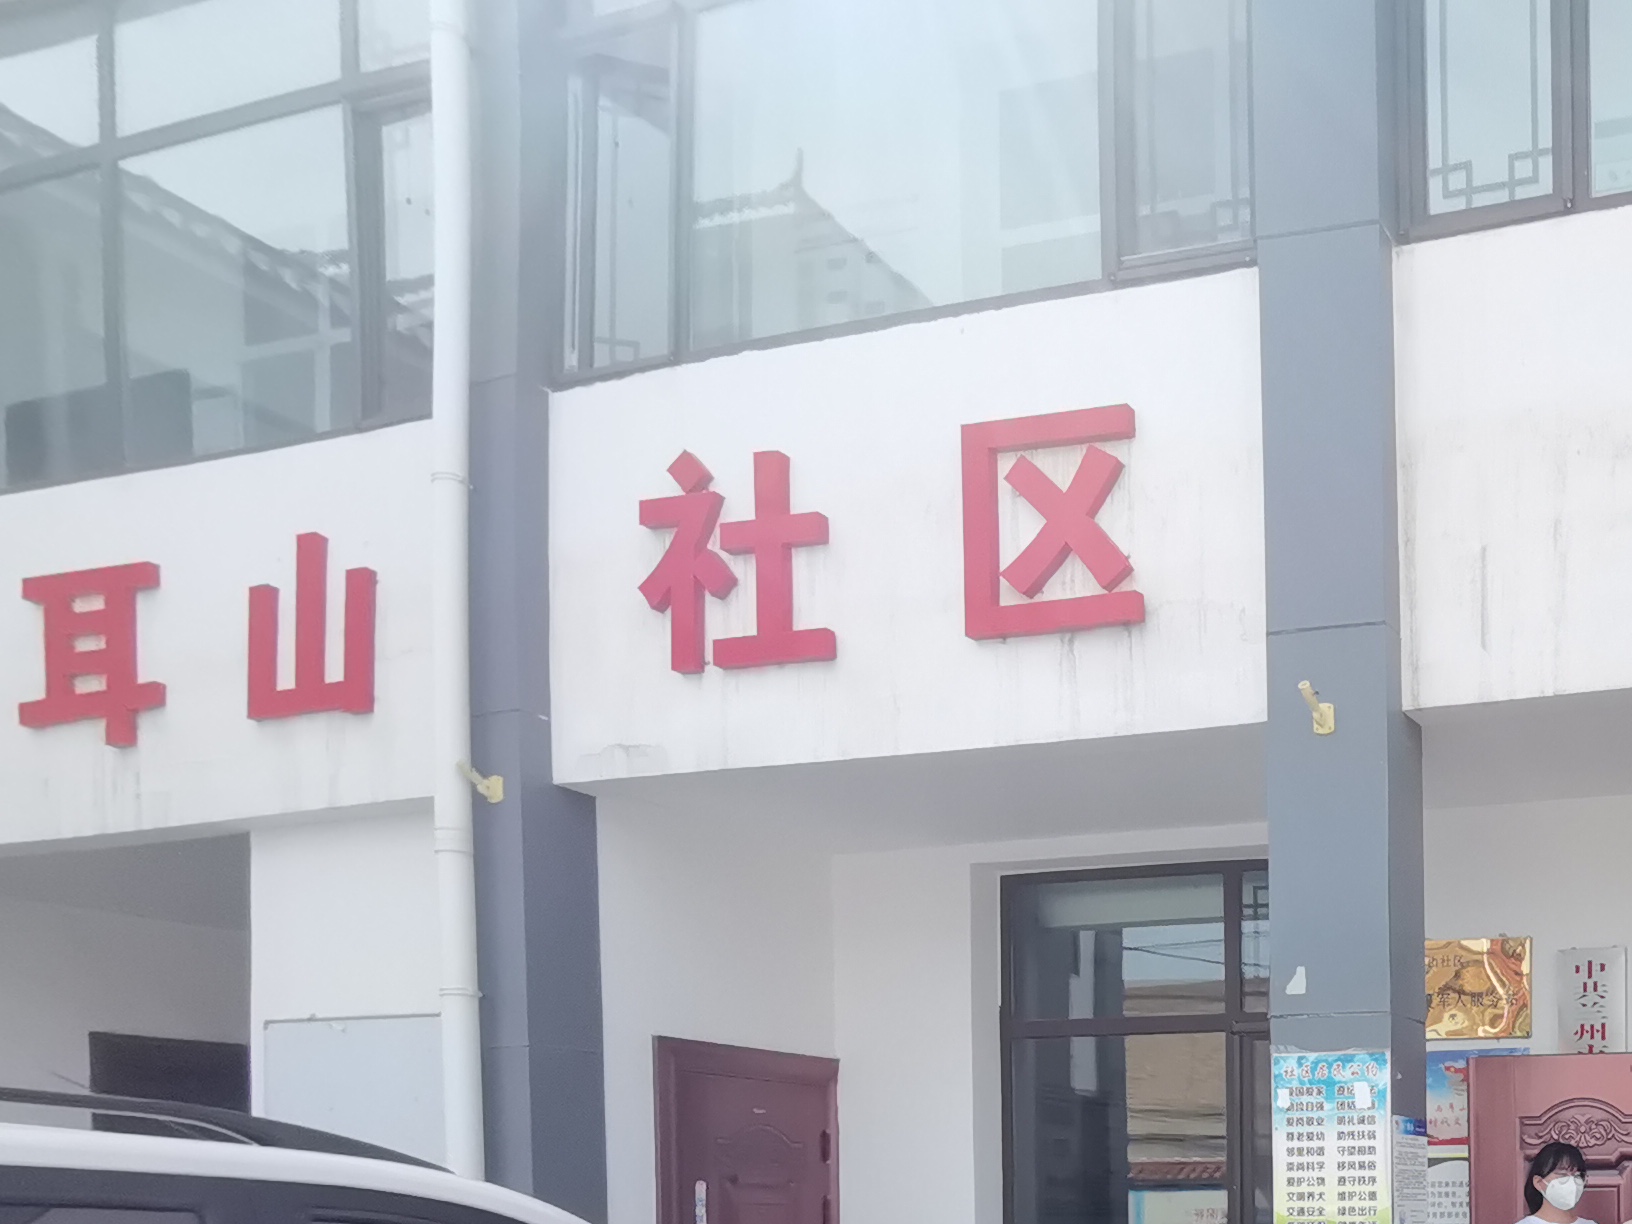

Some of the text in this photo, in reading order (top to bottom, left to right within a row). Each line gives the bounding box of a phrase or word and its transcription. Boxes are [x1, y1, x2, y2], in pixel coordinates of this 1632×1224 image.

[19, 403, 1146, 747] 耳山 社区
[1283, 1061, 1379, 1080] 社区居民公约
[1286, 1130, 1325, 1142] 尊老爱幼
[1286, 1191, 1326, 1202] 文明养犬
[1286, 1206, 1377, 1217] 交通安全 绿色出行
